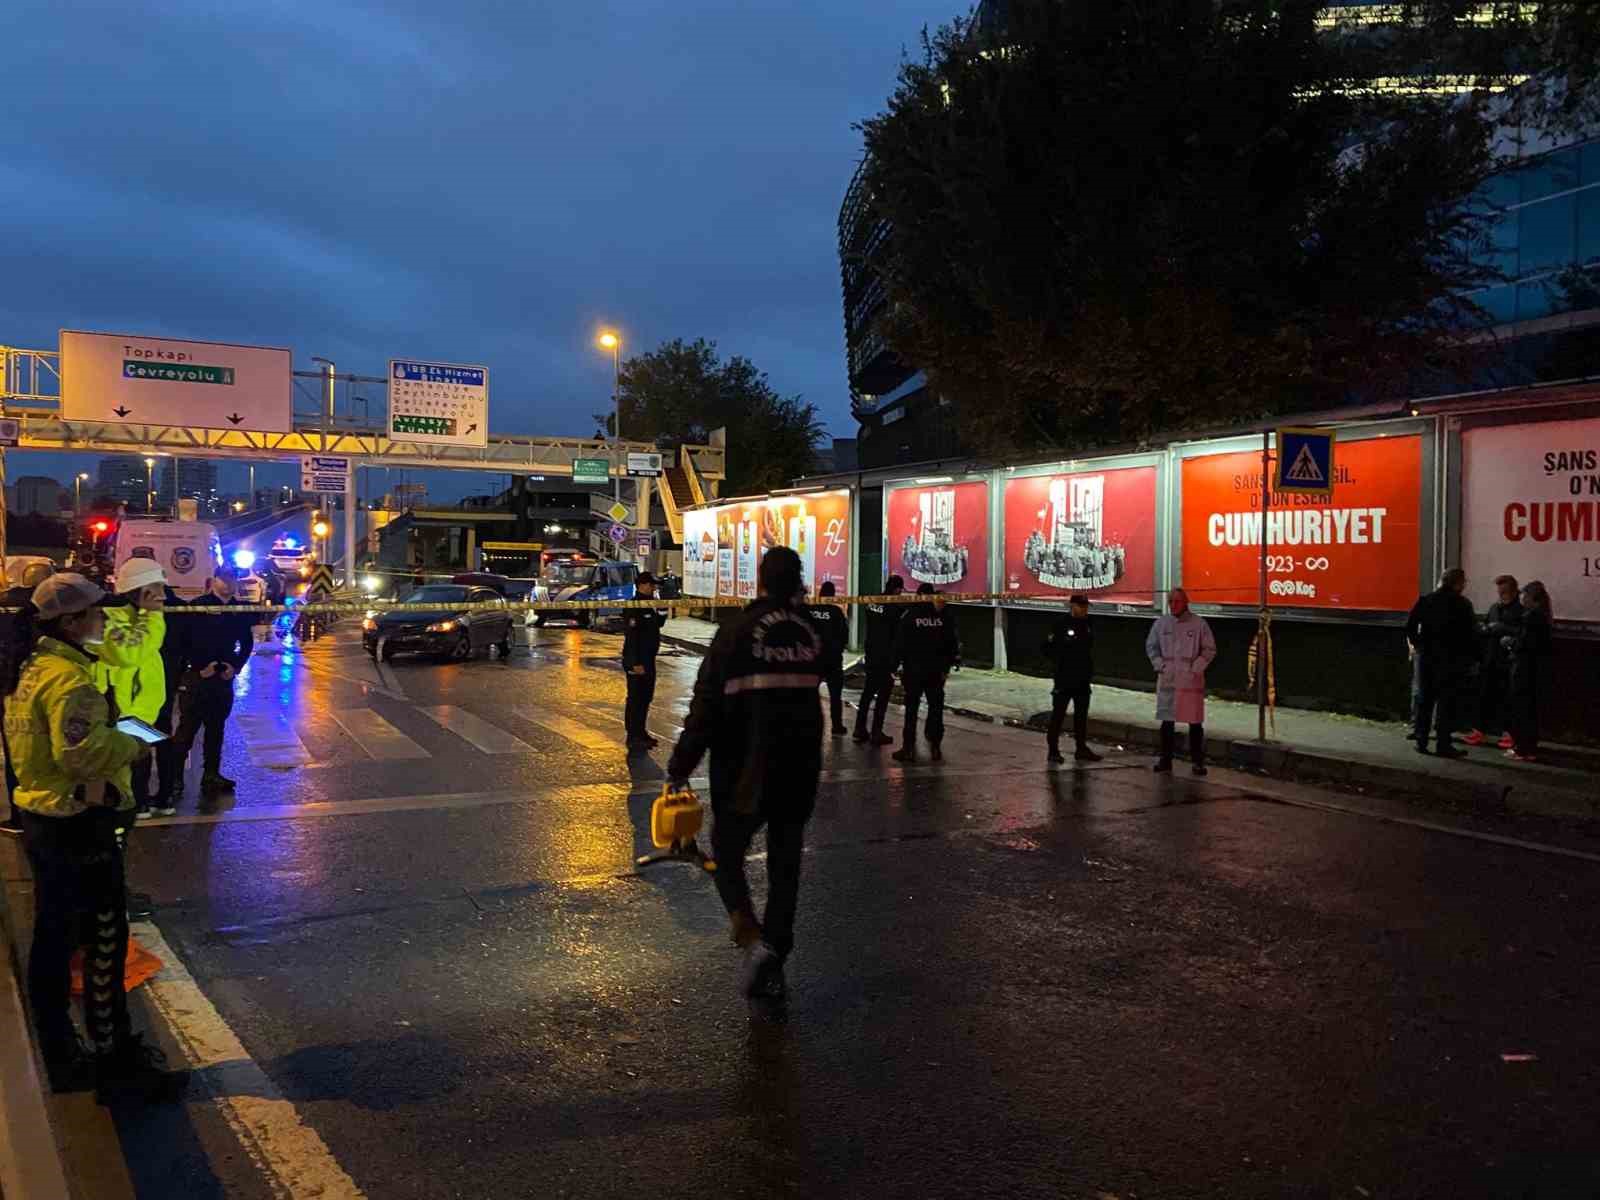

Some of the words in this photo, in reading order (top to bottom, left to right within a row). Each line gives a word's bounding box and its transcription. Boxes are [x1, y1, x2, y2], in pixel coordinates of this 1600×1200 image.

[123, 345, 192, 361] Topkapı
[125, 364, 215, 381] Çevreyolu
[1543, 450, 1597, 476] ŞANS
[1250, 492, 1289, 508] O'UN
[1208, 507, 1387, 547] CUMHURİYET
[1504, 502, 1600, 542] CUM
